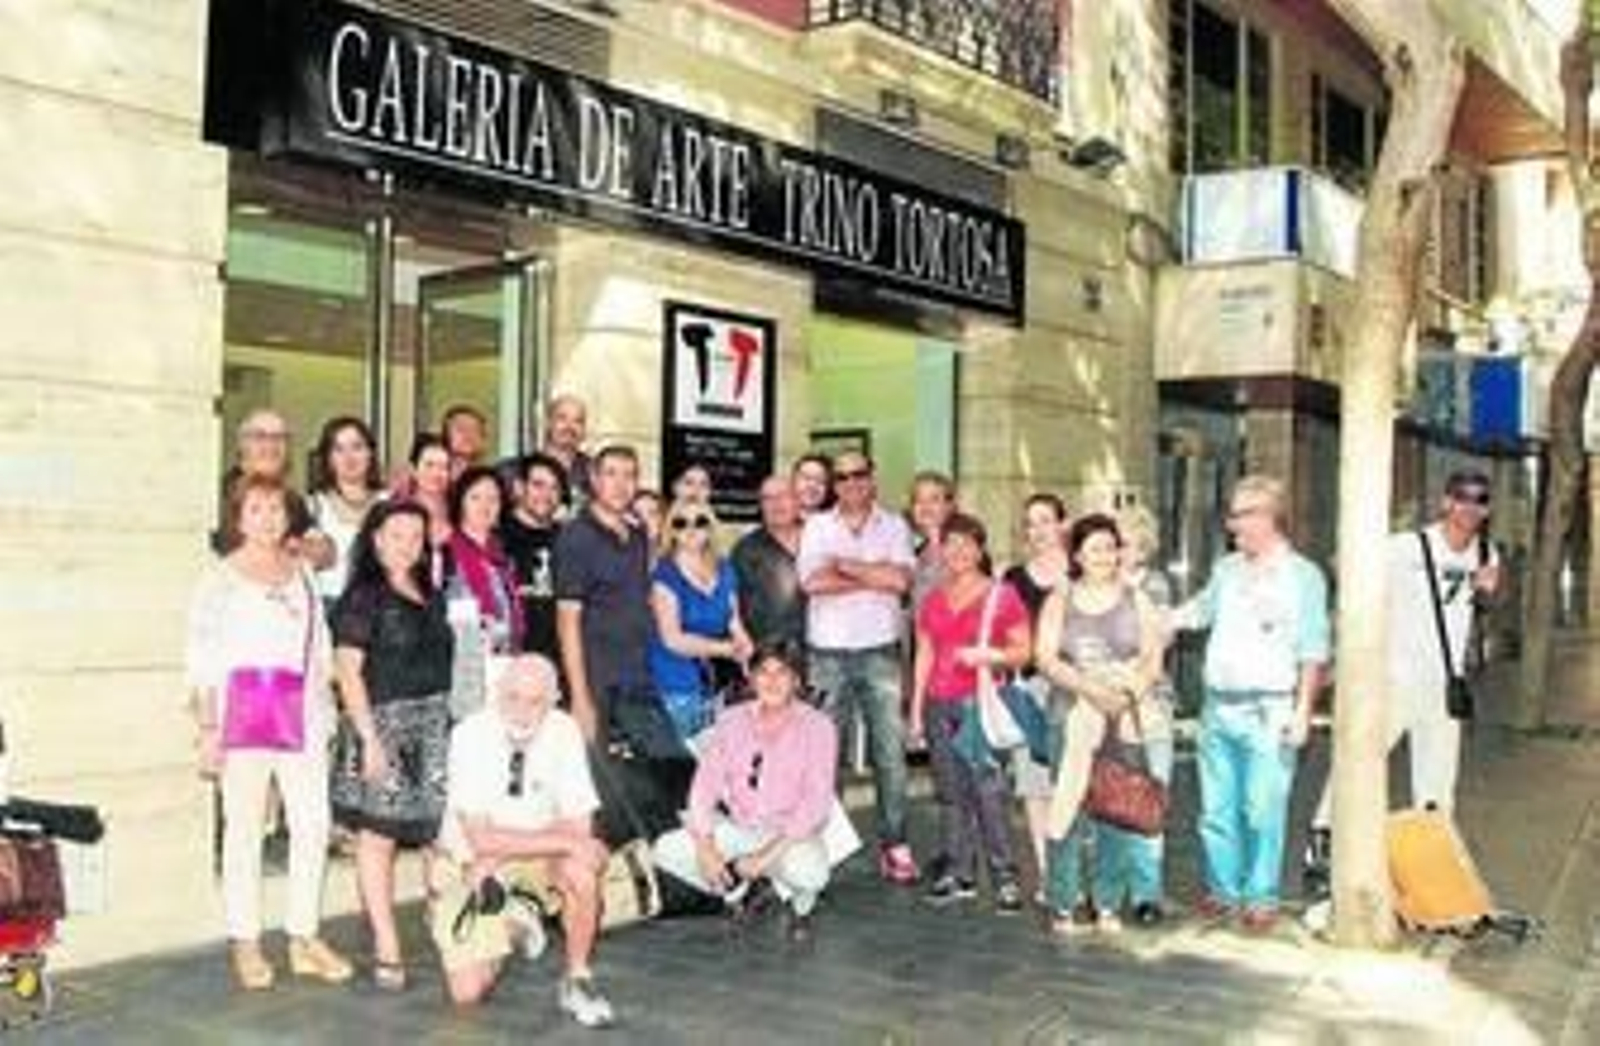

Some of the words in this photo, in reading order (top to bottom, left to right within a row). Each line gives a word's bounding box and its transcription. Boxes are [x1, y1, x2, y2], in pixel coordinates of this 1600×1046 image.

[328, 22, 554, 180] GALERIA
[578, 96, 634, 199] DE
[651, 123, 750, 229] ARTE
[780, 159, 878, 264] TRINO
[890, 193, 1008, 293] TORTOSA
